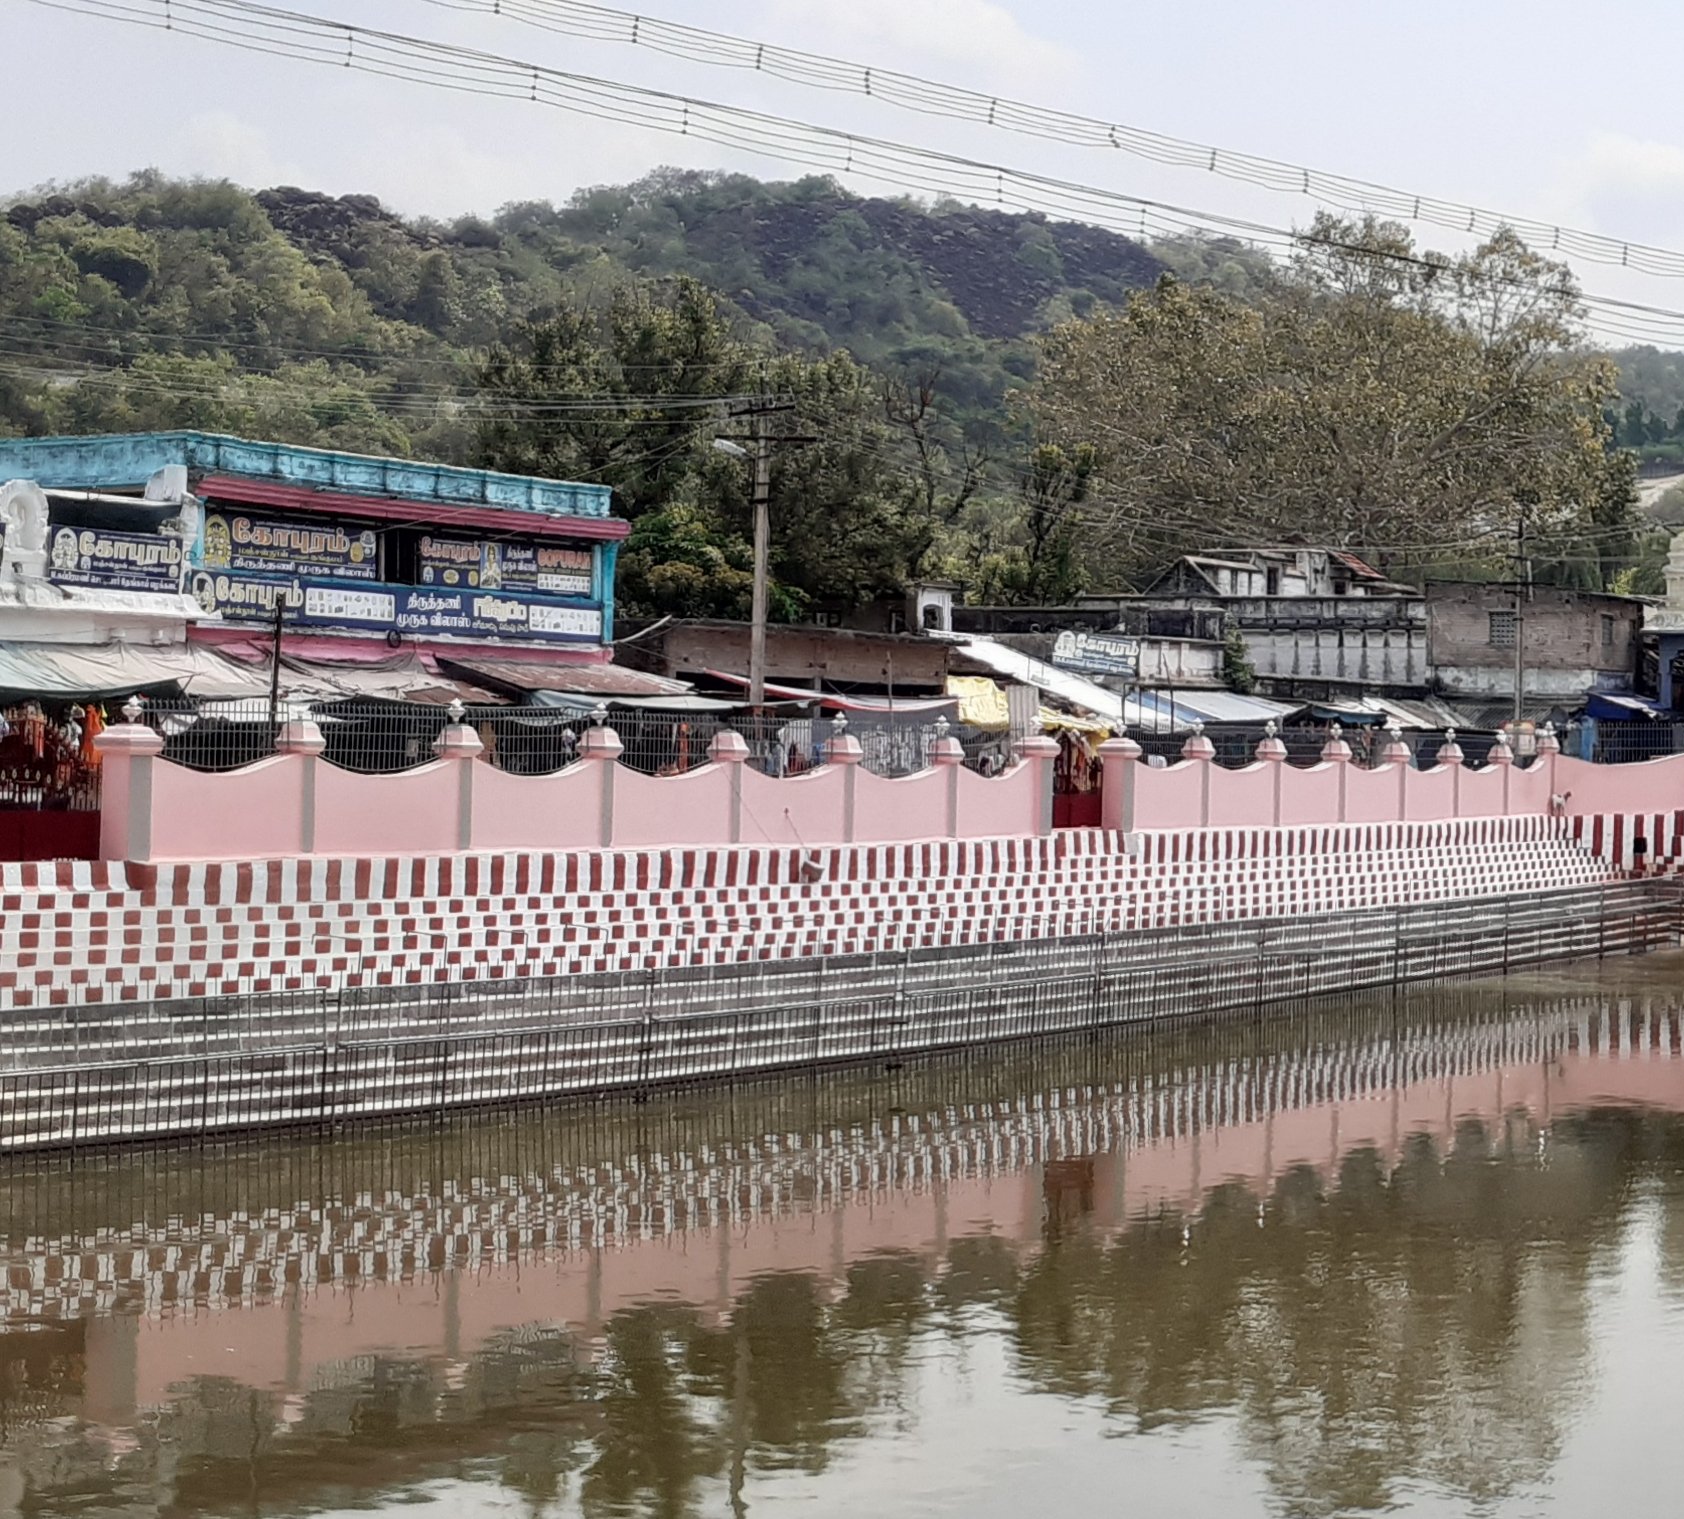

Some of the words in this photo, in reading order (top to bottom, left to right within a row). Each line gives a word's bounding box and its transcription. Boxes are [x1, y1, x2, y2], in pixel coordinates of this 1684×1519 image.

[232, 517, 350, 553] கோபுரம்
[78, 531, 182, 565] கோபுரம்
[420, 536, 480, 563] கோபுரம்
[233, 558, 295, 571] திருத்தணி
[298, 564, 330, 575] முருக
[333, 563, 376, 579] விலாஸ்
[216, 576, 304, 609] கோபுரம்
[407, 592, 461, 610] திருத்தணி
[396, 613, 428, 627] முருக
[431, 612, 471, 628] விலாஸ்
[1077, 633, 1139, 656] கோபுரம்
